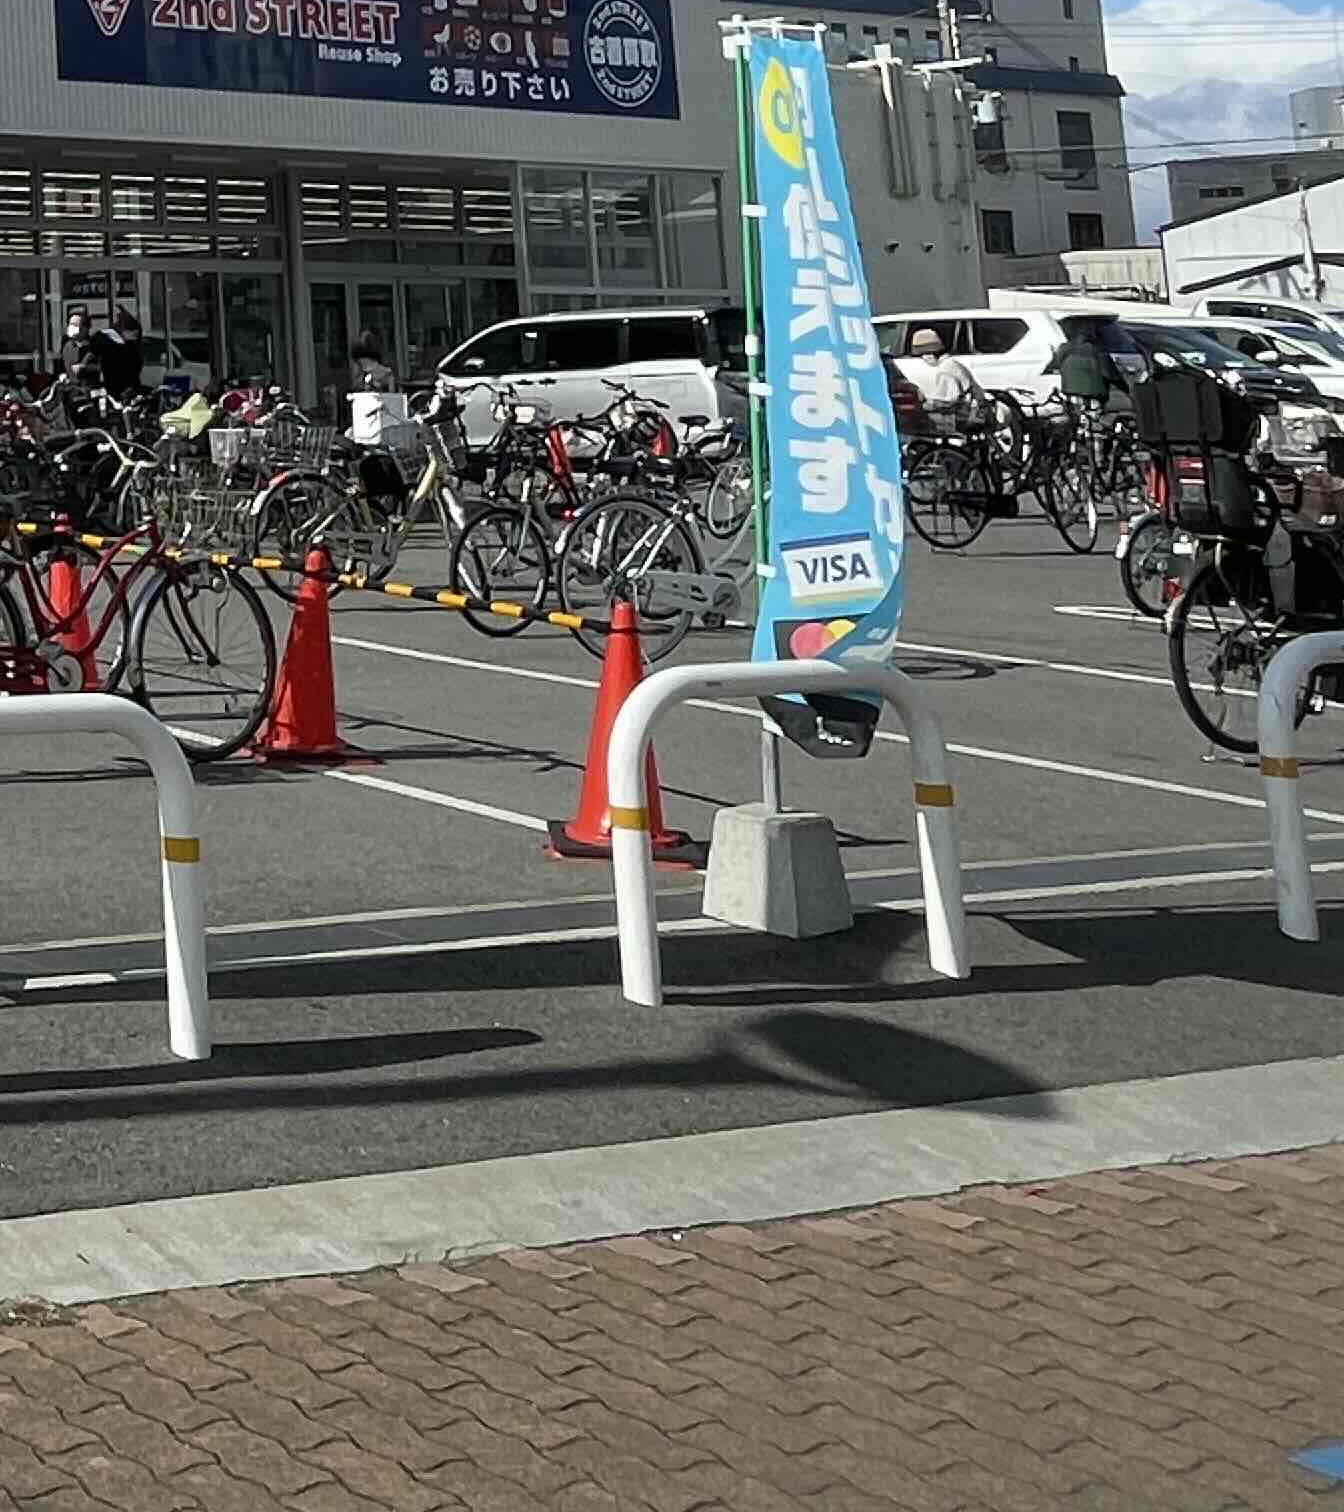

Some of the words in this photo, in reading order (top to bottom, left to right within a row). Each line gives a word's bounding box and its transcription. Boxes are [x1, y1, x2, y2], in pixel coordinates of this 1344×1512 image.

[365, 49, 403, 69] Shop
[428, 65, 573, 102] お売り下さい
[796, 553, 872, 585] VISA
